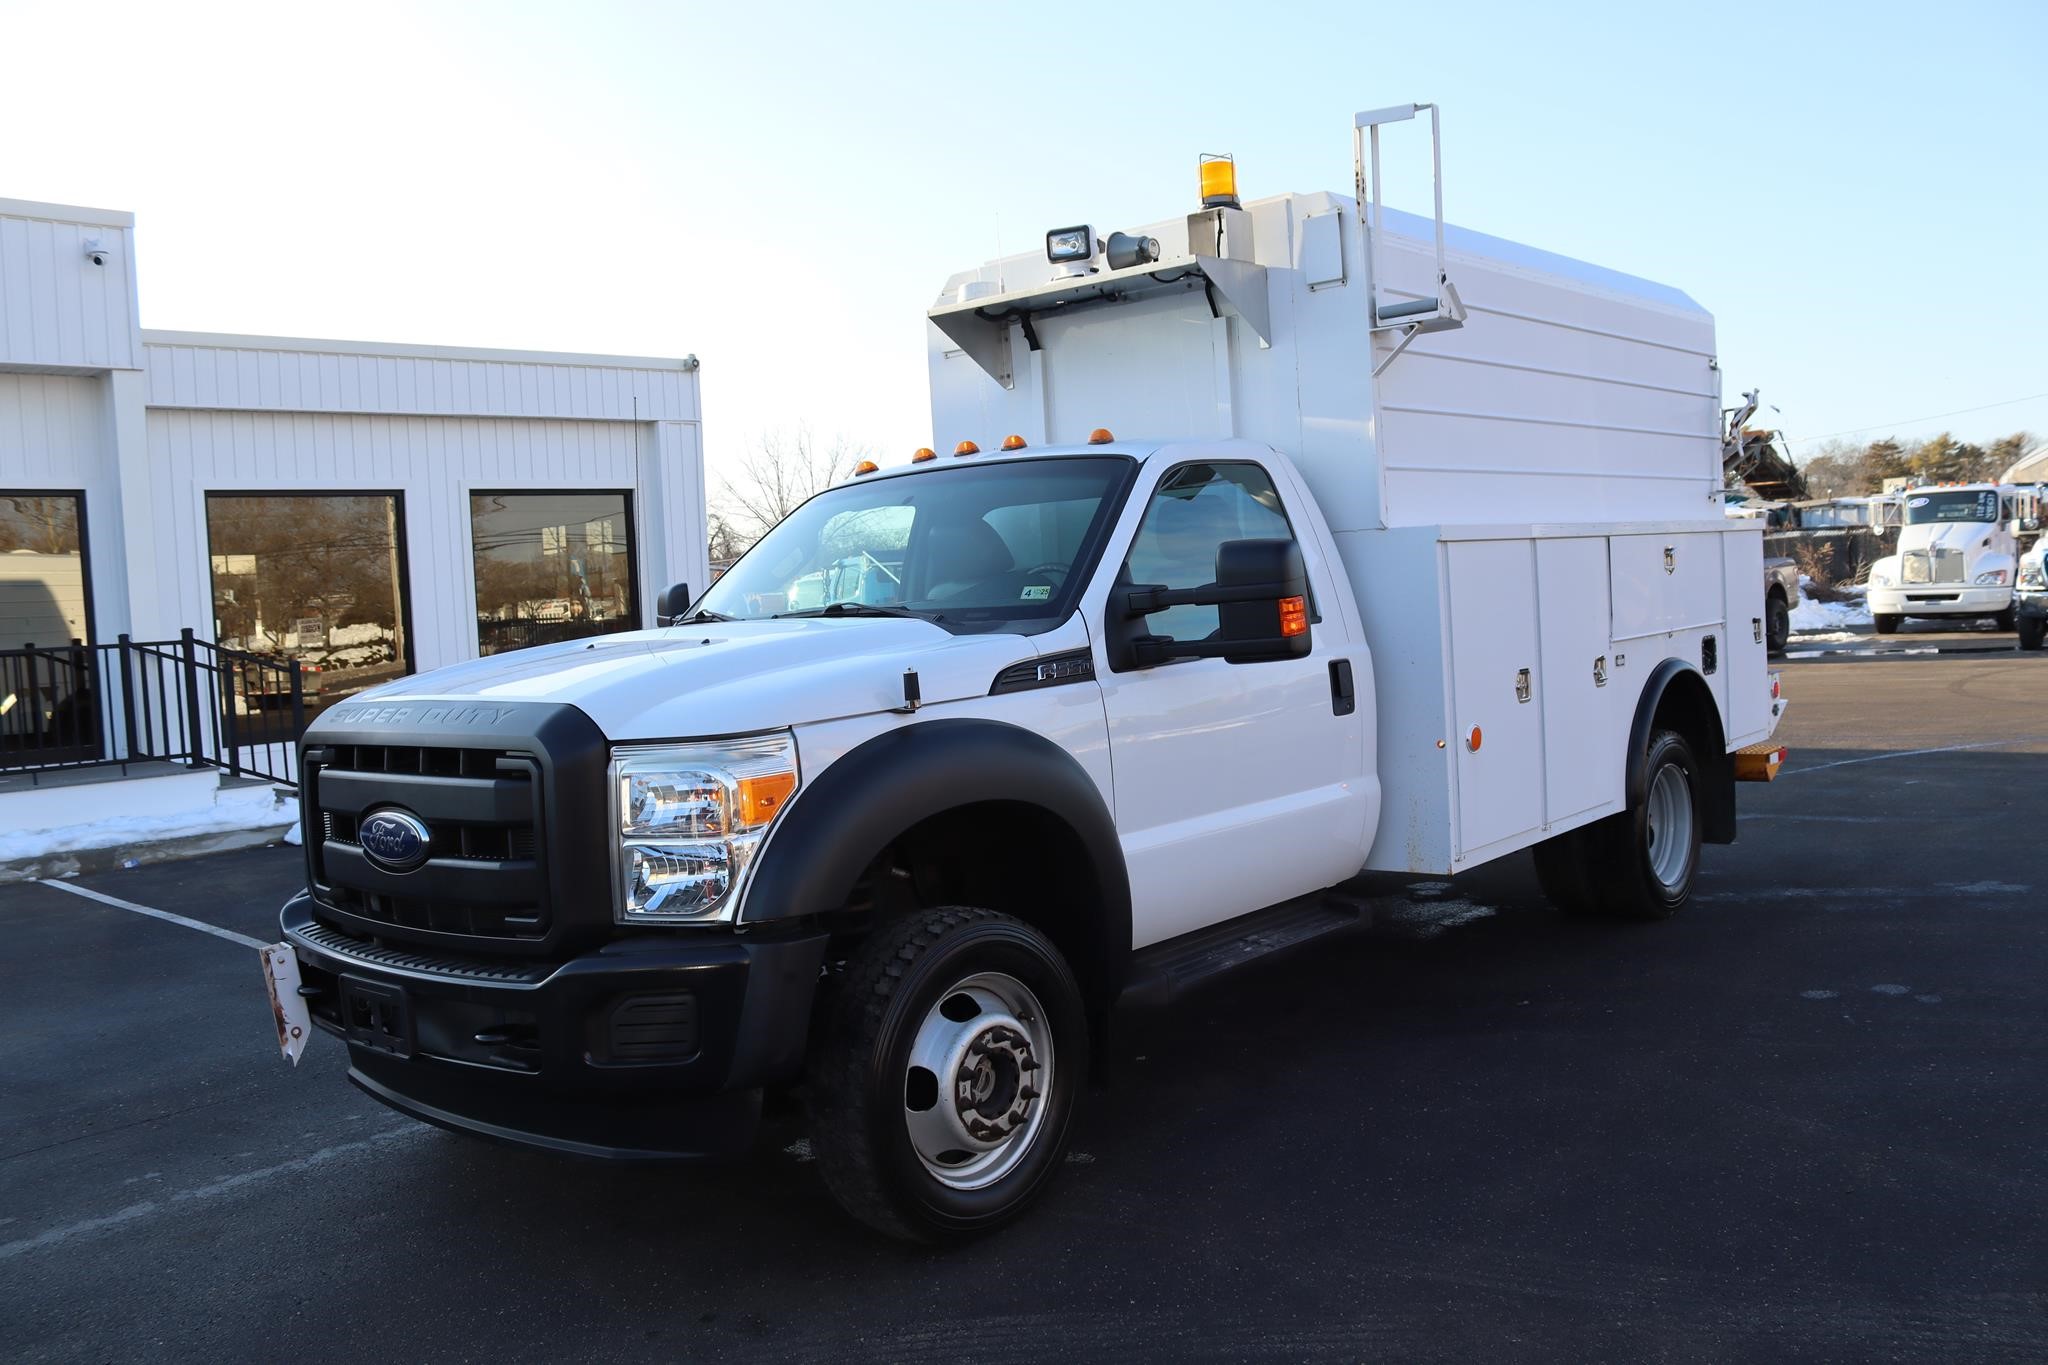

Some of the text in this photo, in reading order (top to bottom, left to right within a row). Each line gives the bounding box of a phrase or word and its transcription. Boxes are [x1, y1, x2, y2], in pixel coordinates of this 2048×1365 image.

[1024, 589, 1032, 597] 4
[331, 706, 517, 725] SUPER DUTY
[369, 820, 405, 852] Ford
